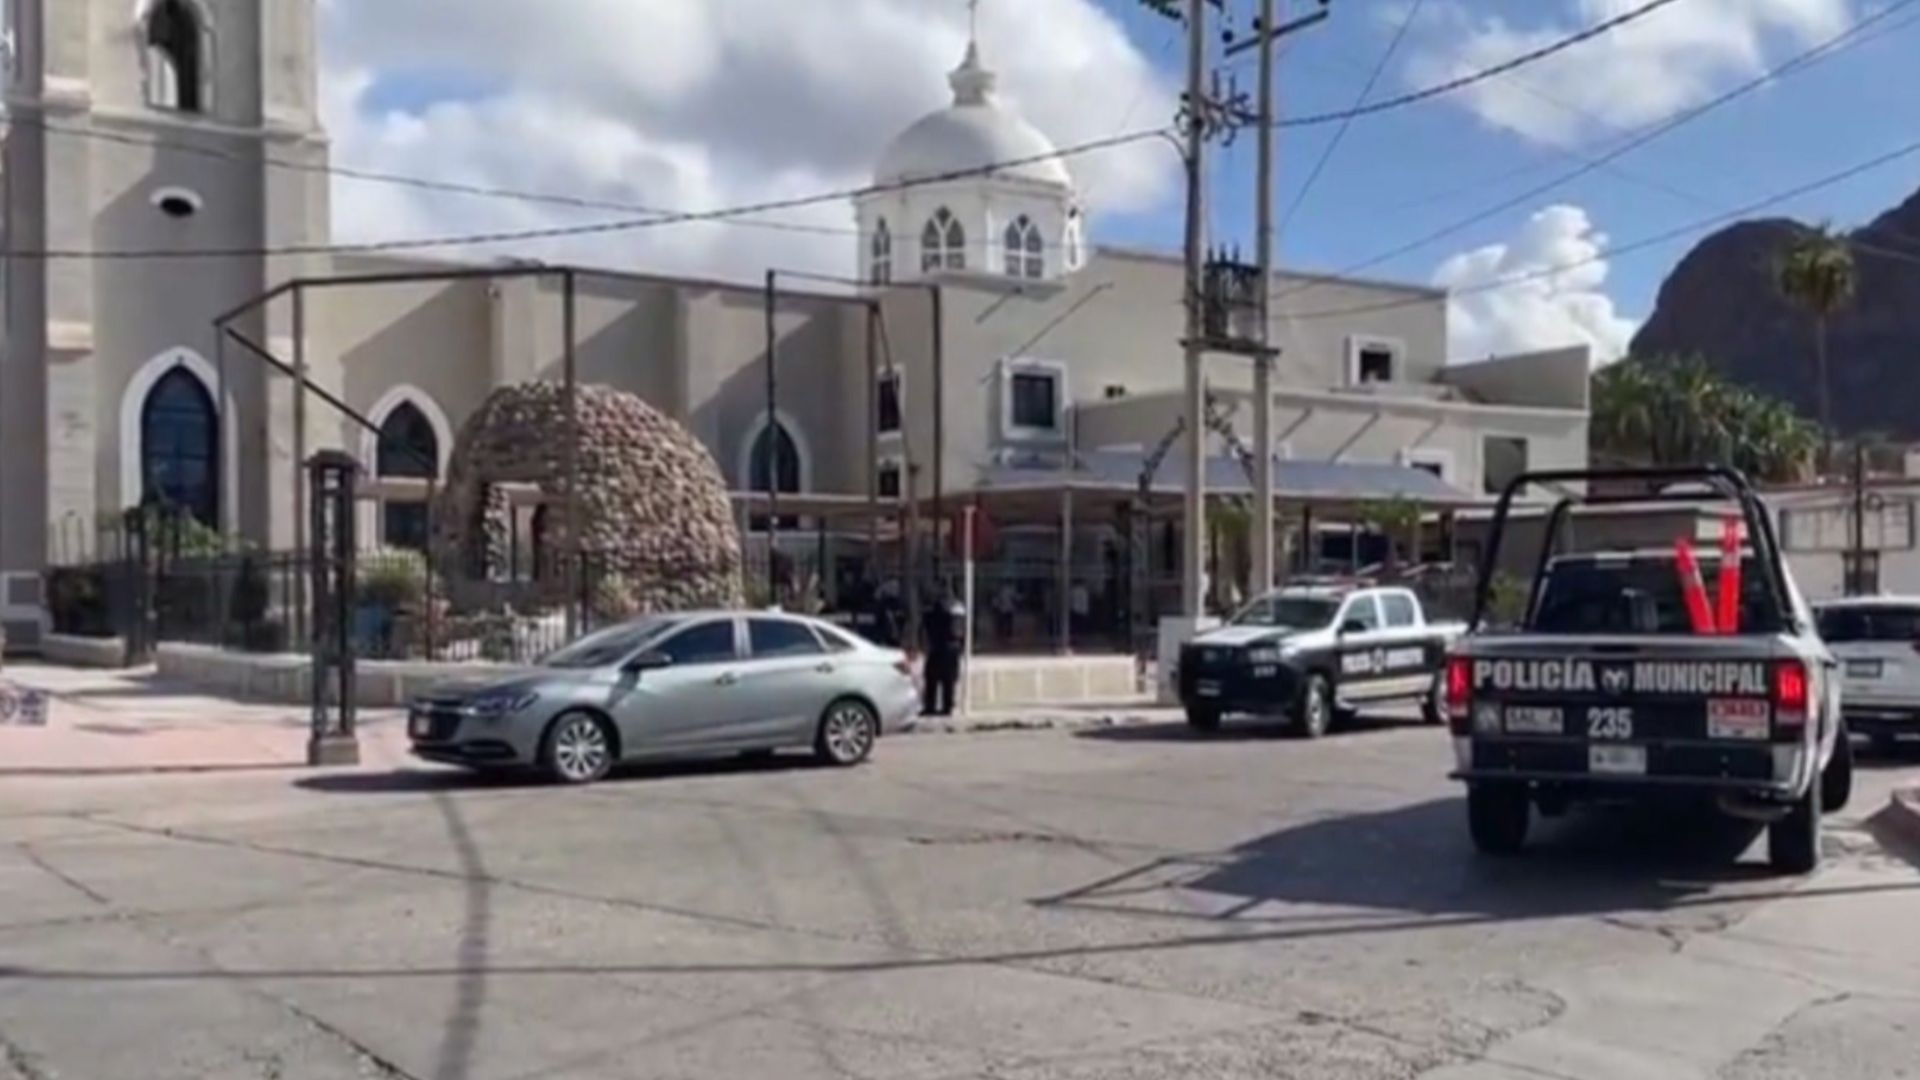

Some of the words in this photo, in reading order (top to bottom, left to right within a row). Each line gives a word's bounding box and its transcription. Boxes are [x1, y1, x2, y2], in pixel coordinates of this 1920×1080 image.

[1474, 655, 1596, 691] POLICÍA
[1633, 661, 1767, 693] MUNICIPAL
[1587, 706, 1633, 738] 235
